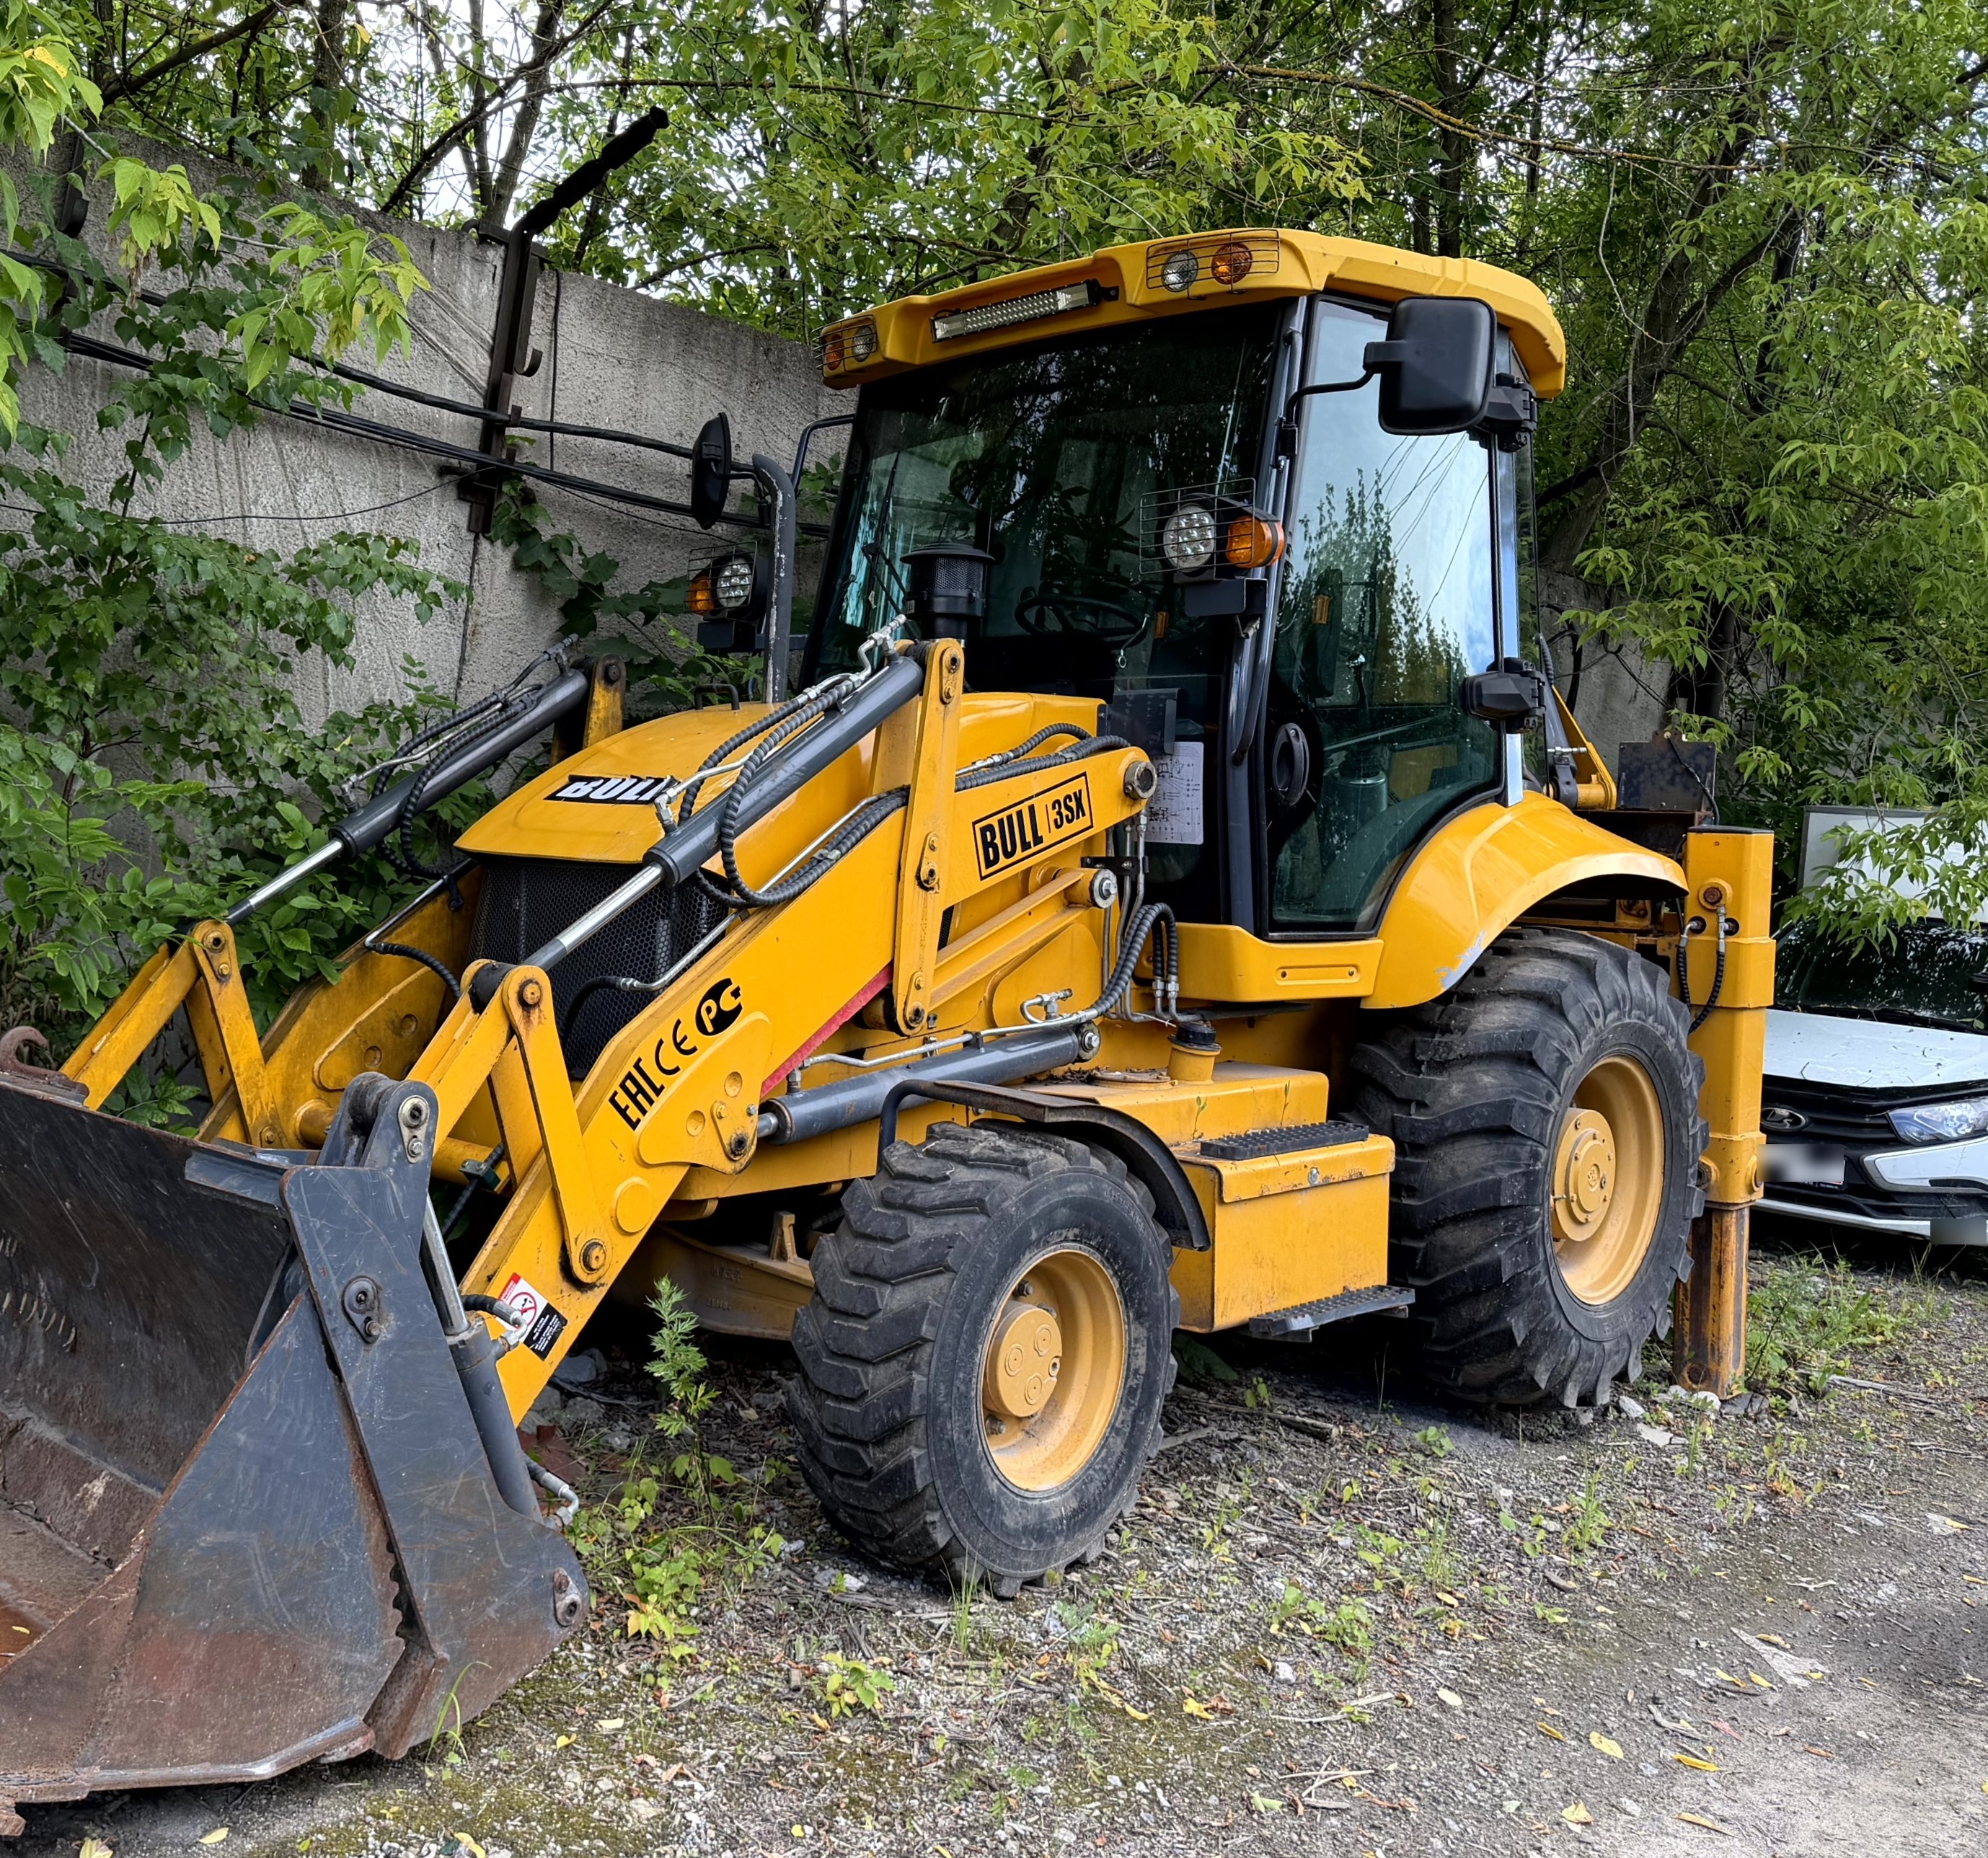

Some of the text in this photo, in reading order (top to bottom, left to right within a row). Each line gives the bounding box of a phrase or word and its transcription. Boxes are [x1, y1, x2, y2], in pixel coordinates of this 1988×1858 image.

[979, 803, 1044, 870] BULL
[1051, 788, 1087, 830] 3SX
[608, 1056, 666, 1132] EAC
